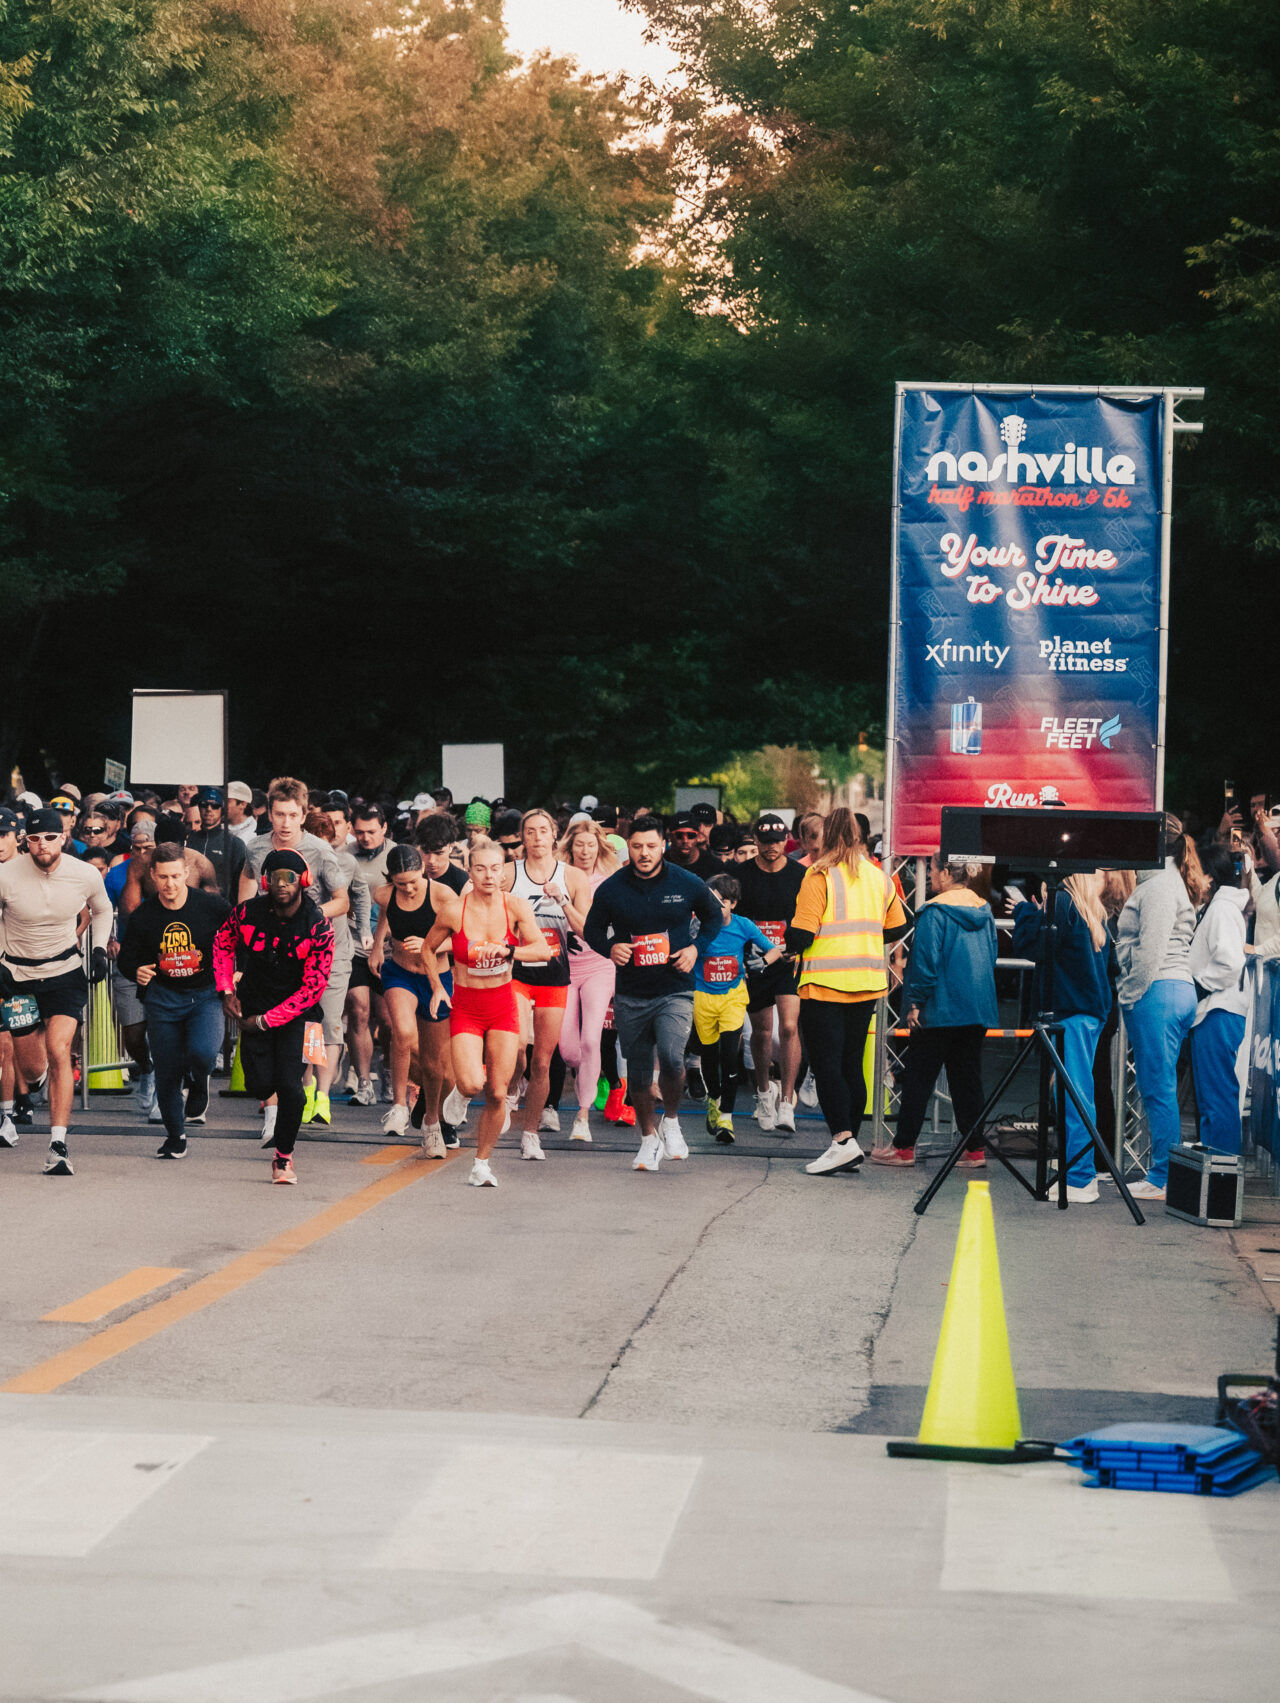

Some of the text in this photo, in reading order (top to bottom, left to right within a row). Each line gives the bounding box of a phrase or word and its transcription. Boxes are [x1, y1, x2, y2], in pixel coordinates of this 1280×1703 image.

[924, 442, 1136, 485] nashville
[927, 484, 975, 513] half
[977, 486, 1082, 507] marathon
[1085, 489, 1101, 505] &
[940, 532, 1118, 578] Your Time
[966, 571, 1100, 611] to Shine
[925, 638, 1010, 669] xfinity
[1039, 636, 1112, 657] planet
[1048, 653, 1129, 672] fitness
[1040, 717, 1102, 733] FLEET
[1045, 733, 1096, 749] FEET
[984, 783, 1038, 808] Run
[164, 931, 189, 948] ZOO
[475, 957, 503, 969] 3073
[639, 952, 666, 966] 3098
[168, 967, 194, 978] 2998
[709, 971, 733, 982] 3012
[8, 1012, 33, 1028] 2398
